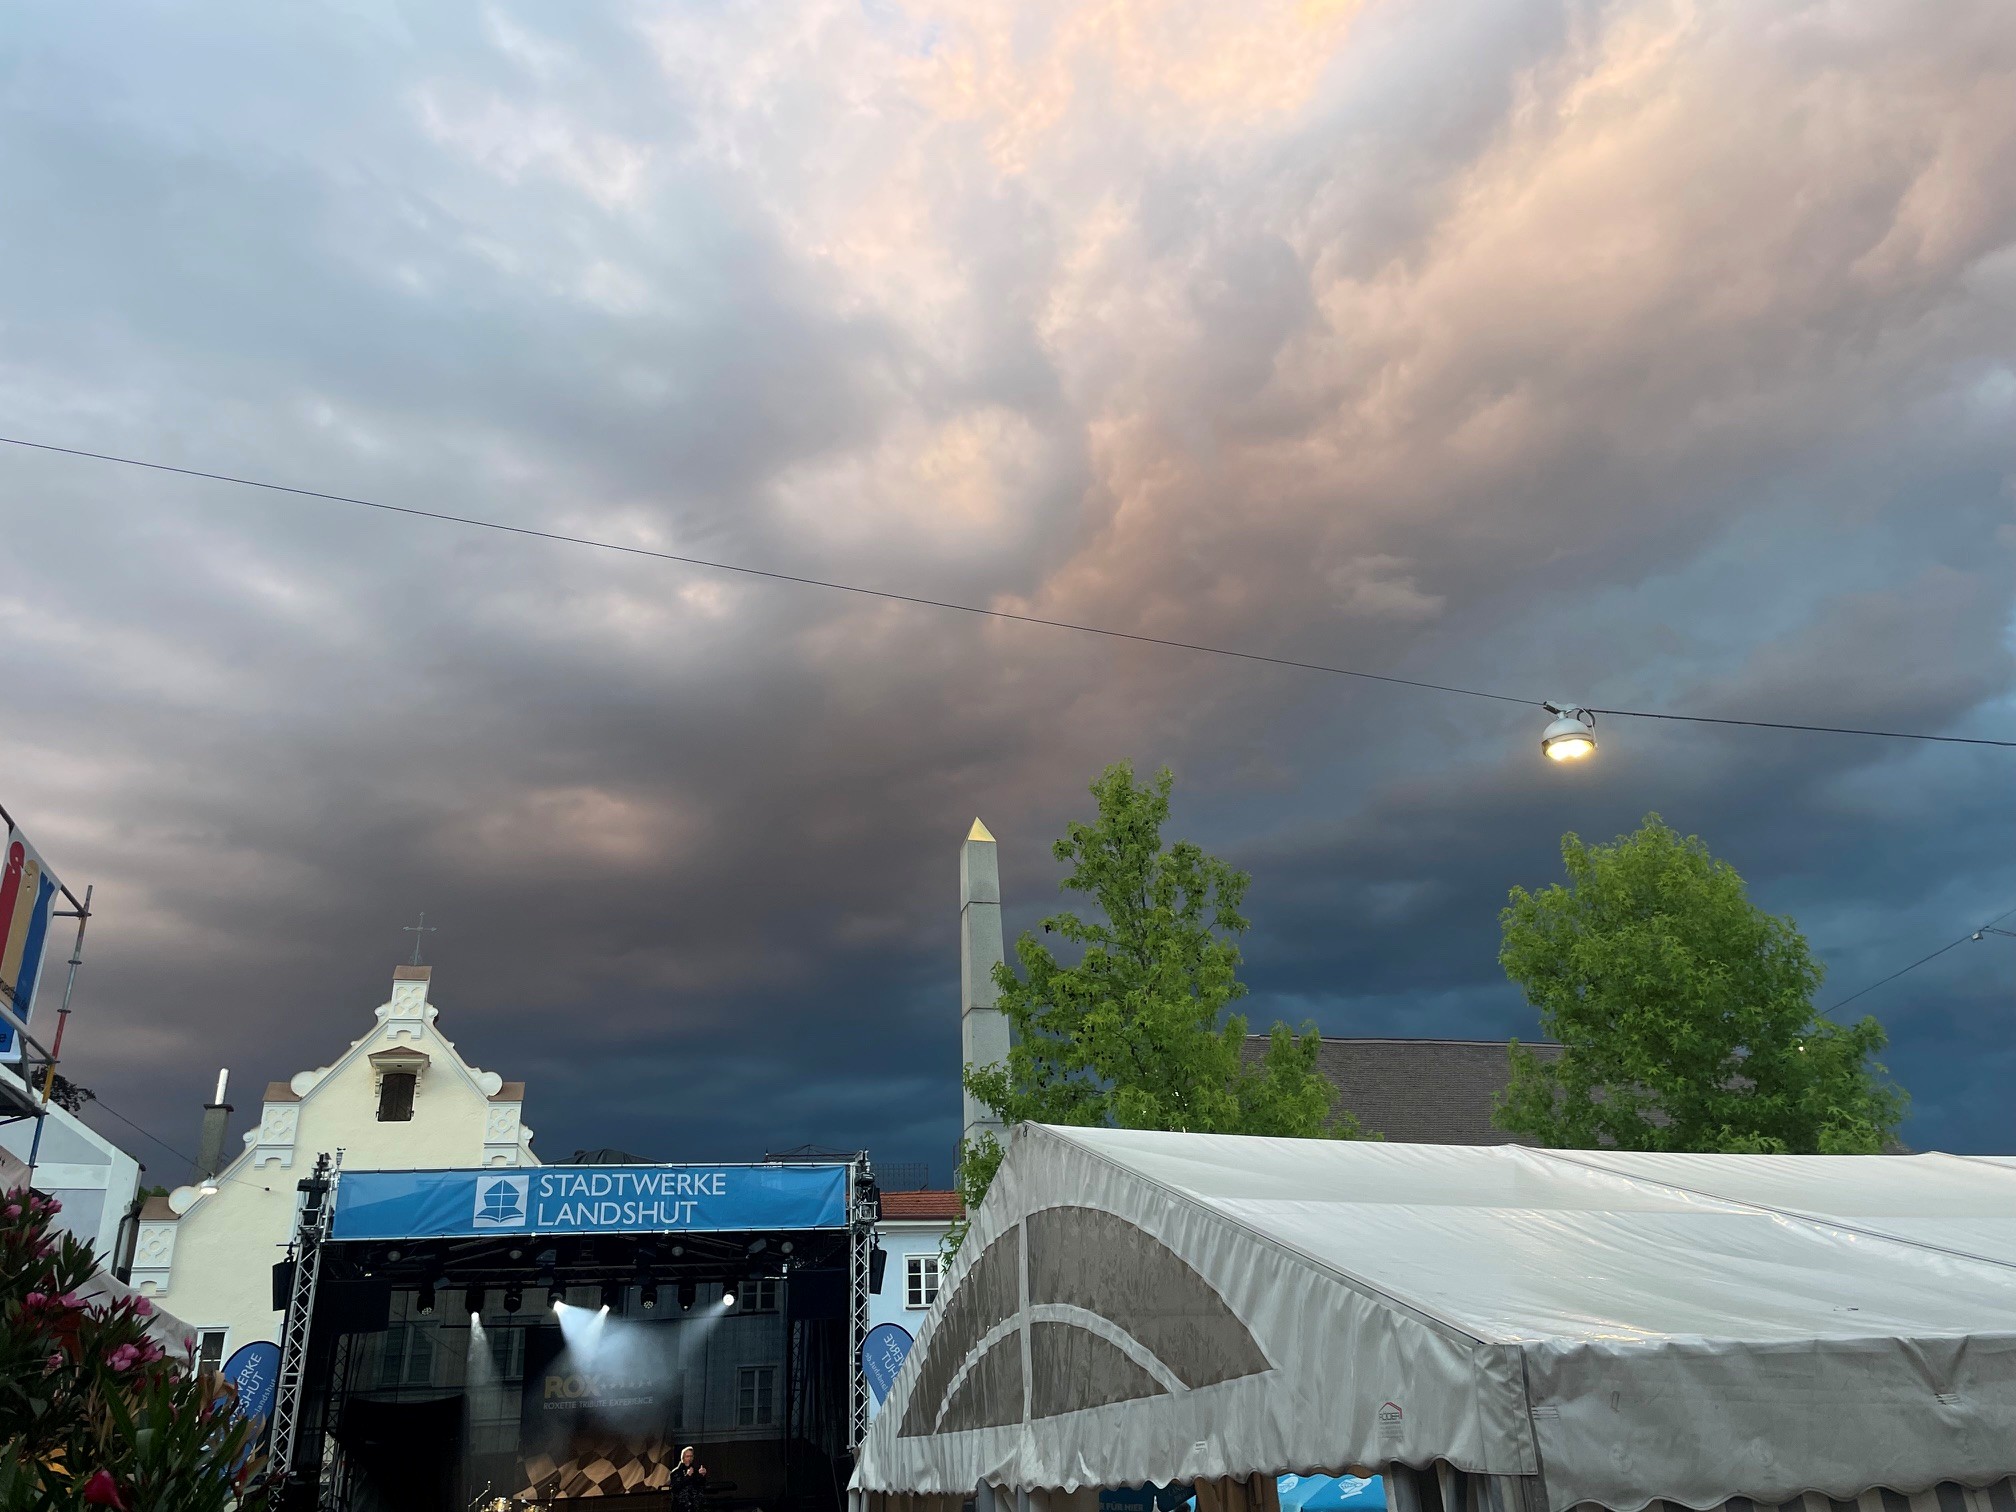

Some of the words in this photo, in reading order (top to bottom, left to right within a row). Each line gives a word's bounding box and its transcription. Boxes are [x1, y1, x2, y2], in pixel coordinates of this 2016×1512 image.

[540, 1173, 726, 1197] STADTWERKE
[537, 1201, 698, 1226] LANDSHUT
[544, 1374, 602, 1399] ROX
[543, 1401, 576, 1410] ROXETTE
[579, 1399, 608, 1408] TRIBUTE
[609, 1396, 654, 1407] EXPERIENCE
